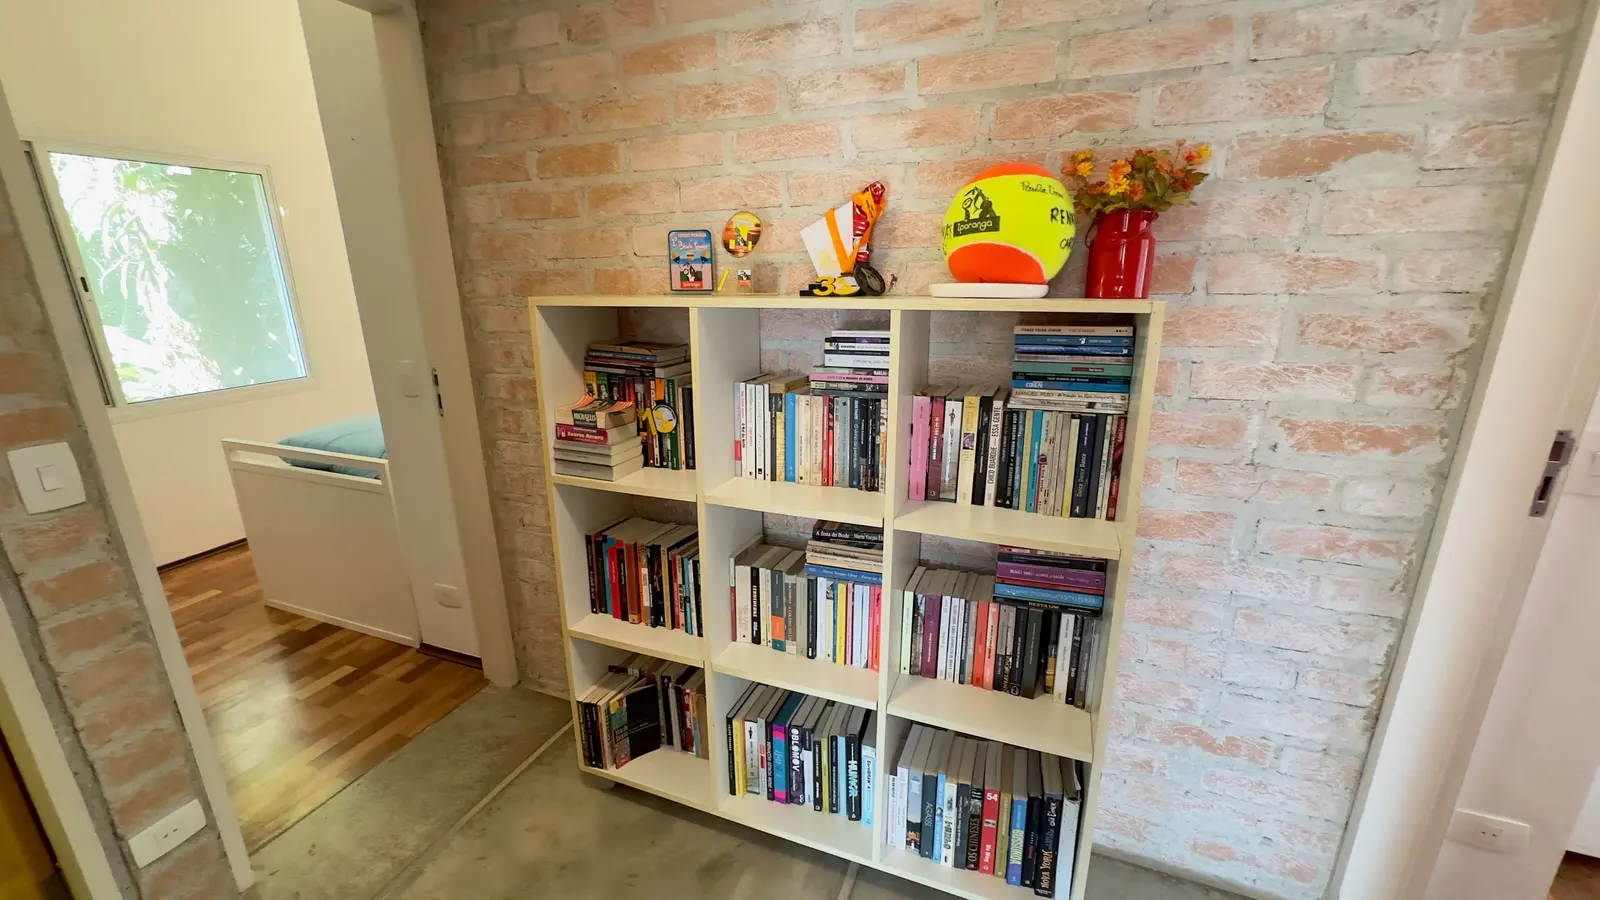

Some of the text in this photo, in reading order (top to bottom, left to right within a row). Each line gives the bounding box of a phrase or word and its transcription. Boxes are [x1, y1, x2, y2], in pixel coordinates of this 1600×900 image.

[812, 276, 834, 296] 3
[992, 406, 1001, 422] GENTE
[989, 446, 998, 468] BUARQUE
[791, 728, 800, 772] OBLOMOV
[848, 760, 858, 797] HUMOR
[986, 793, 998, 801] 54
[924, 802, 933, 827] AGASSI
[968, 818, 979, 862] OS CHINESES
[1010, 829, 1024, 864] BUSSUNDA
[1040, 849, 1053, 869] YORK
[1040, 872, 1051, 888] NOVA
